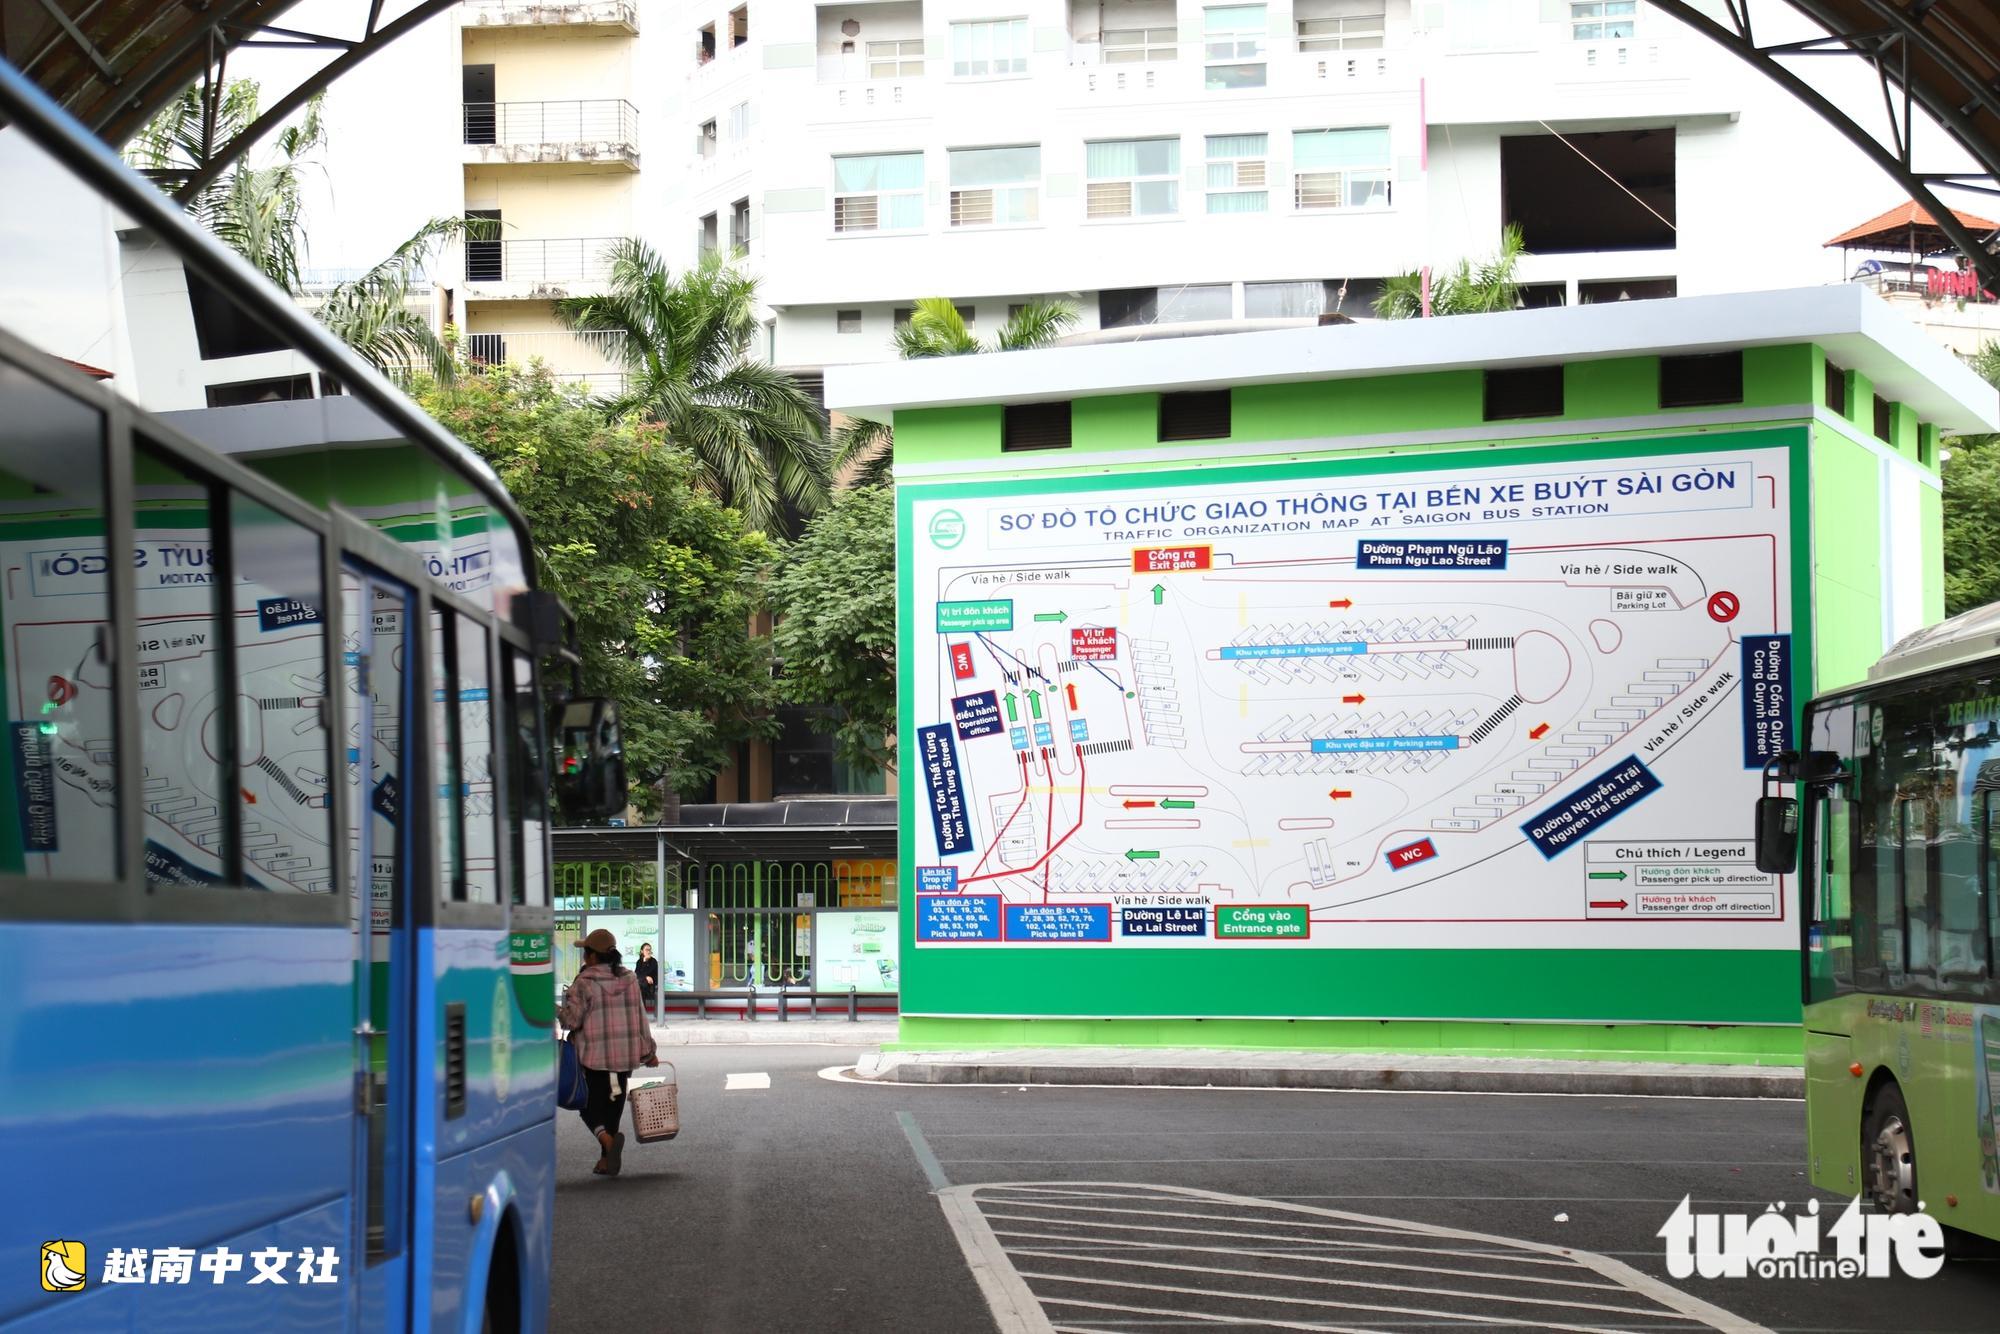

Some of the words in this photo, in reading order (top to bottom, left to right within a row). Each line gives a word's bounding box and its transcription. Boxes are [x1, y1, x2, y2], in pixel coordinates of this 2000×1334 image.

[1000, 513, 1035, 531] SƠ
[1125, 501, 1196, 524] CHỨC
[1206, 501, 1267, 520] GIAO
[1276, 492, 1368, 516] THÔNG
[1376, 491, 1416, 514] TẠI
[1427, 484, 1480, 507] BẾN
[1490, 484, 1524, 503] XE
[1535, 476, 1607, 500] BUÝT
[1617, 472, 1662, 495] SÀI
[1672, 468, 1735, 492] GÒN
[1103, 528, 1172, 541] TRAFFIC
[1183, 521, 1311, 537] ORGANIZATION
[1322, 518, 1359, 529] MAP
[1371, 516, 1391, 526] AT
[1402, 512, 1471, 524] SAIGON
[1483, 508, 1520, 520] BUS
[1532, 503, 1609, 517] STATION
[1148, 548, 1180, 562] Cổng
[1183, 550, 1195, 559] ra
[1363, 543, 1404, 556] Đường
[1408, 544, 1444, 556] Phạm
[1150, 560, 1171, 570] Exit
[1173, 560, 1196, 571] gate
[1370, 556, 1402, 565] Pham
[1405, 556, 1428, 566] Ngu
[1432, 556, 1453, 565] Lao
[1456, 556, 1491, 565] Street
[1585, 564, 1601, 574] hè
[1613, 564, 1643, 574] Side
[1647, 564, 1678, 574] walk
[993, 573, 1006, 584] hè
[1016, 572, 1041, 582] Side
[1044, 570, 1071, 580] walk
[1656, 591, 1667, 599] xe
[1617, 602, 1649, 611] Parking
[1087, 636, 1114, 645] khách
[1305, 646, 1334, 654] Parking
[957, 653, 969, 671] WC
[1752, 649, 1765, 680] Cong
[1767, 640, 1781, 680] Đường
[966, 697, 984, 707] Nhà
[1662, 722, 1679, 737] hè
[1682, 695, 1708, 718] Side
[1707, 672, 1734, 695] walk
[1753, 682, 1767, 718] Quynh
[976, 705, 998, 717] hành
[958, 715, 998, 729] Operations
[969, 726, 991, 736] office
[1756, 721, 1768, 755] Street
[926, 731, 938, 761] Tùng
[1393, 740, 1424, 748] Parking
[1769, 720, 1785, 758] Quỳn
[939, 737, 952, 768] Street
[946, 769, 957, 795] Tung
[936, 789, 947, 812] Tôn
[950, 795, 961, 820] That
[1532, 811, 1573, 839] Đường
[1570, 782, 1617, 814] Nguyễn
[1614, 764, 1641, 784] Trãi
[1548, 816, 1590, 846] Nguyen
[1587, 801, 1612, 818] Trai
[1610, 780, 1644, 805] Street
[941, 812, 955, 850] Đường
[955, 820, 965, 840] Ton
[1399, 847, 1423, 862] WC
[1615, 847, 1643, 858] Chú
[1647, 847, 1681, 858] thích
[1694, 846, 1746, 860] Legend
[1641, 876, 1688, 884] Passenger
[1691, 876, 1710, 884] pick
[1134, 895, 1147, 905] hè
[1157, 895, 1182, 905] Side
[1185, 895, 1211, 905] walk
[1642, 904, 1689, 912] Passenger
[1124, 909, 1163, 922] Đường
[1166, 909, 1181, 920] Lê
[1185, 909, 1203, 920] Lai
[1232, 909, 1265, 923] Cổng
[1269, 910, 1291, 921] vào
[1129, 923, 1143, 932] Le
[1148, 923, 1162, 932] Lai
[1165, 923, 1198, 933] Street
[1223, 924, 1273, 933] Entrance
[1276, 924, 1301, 934] gate
